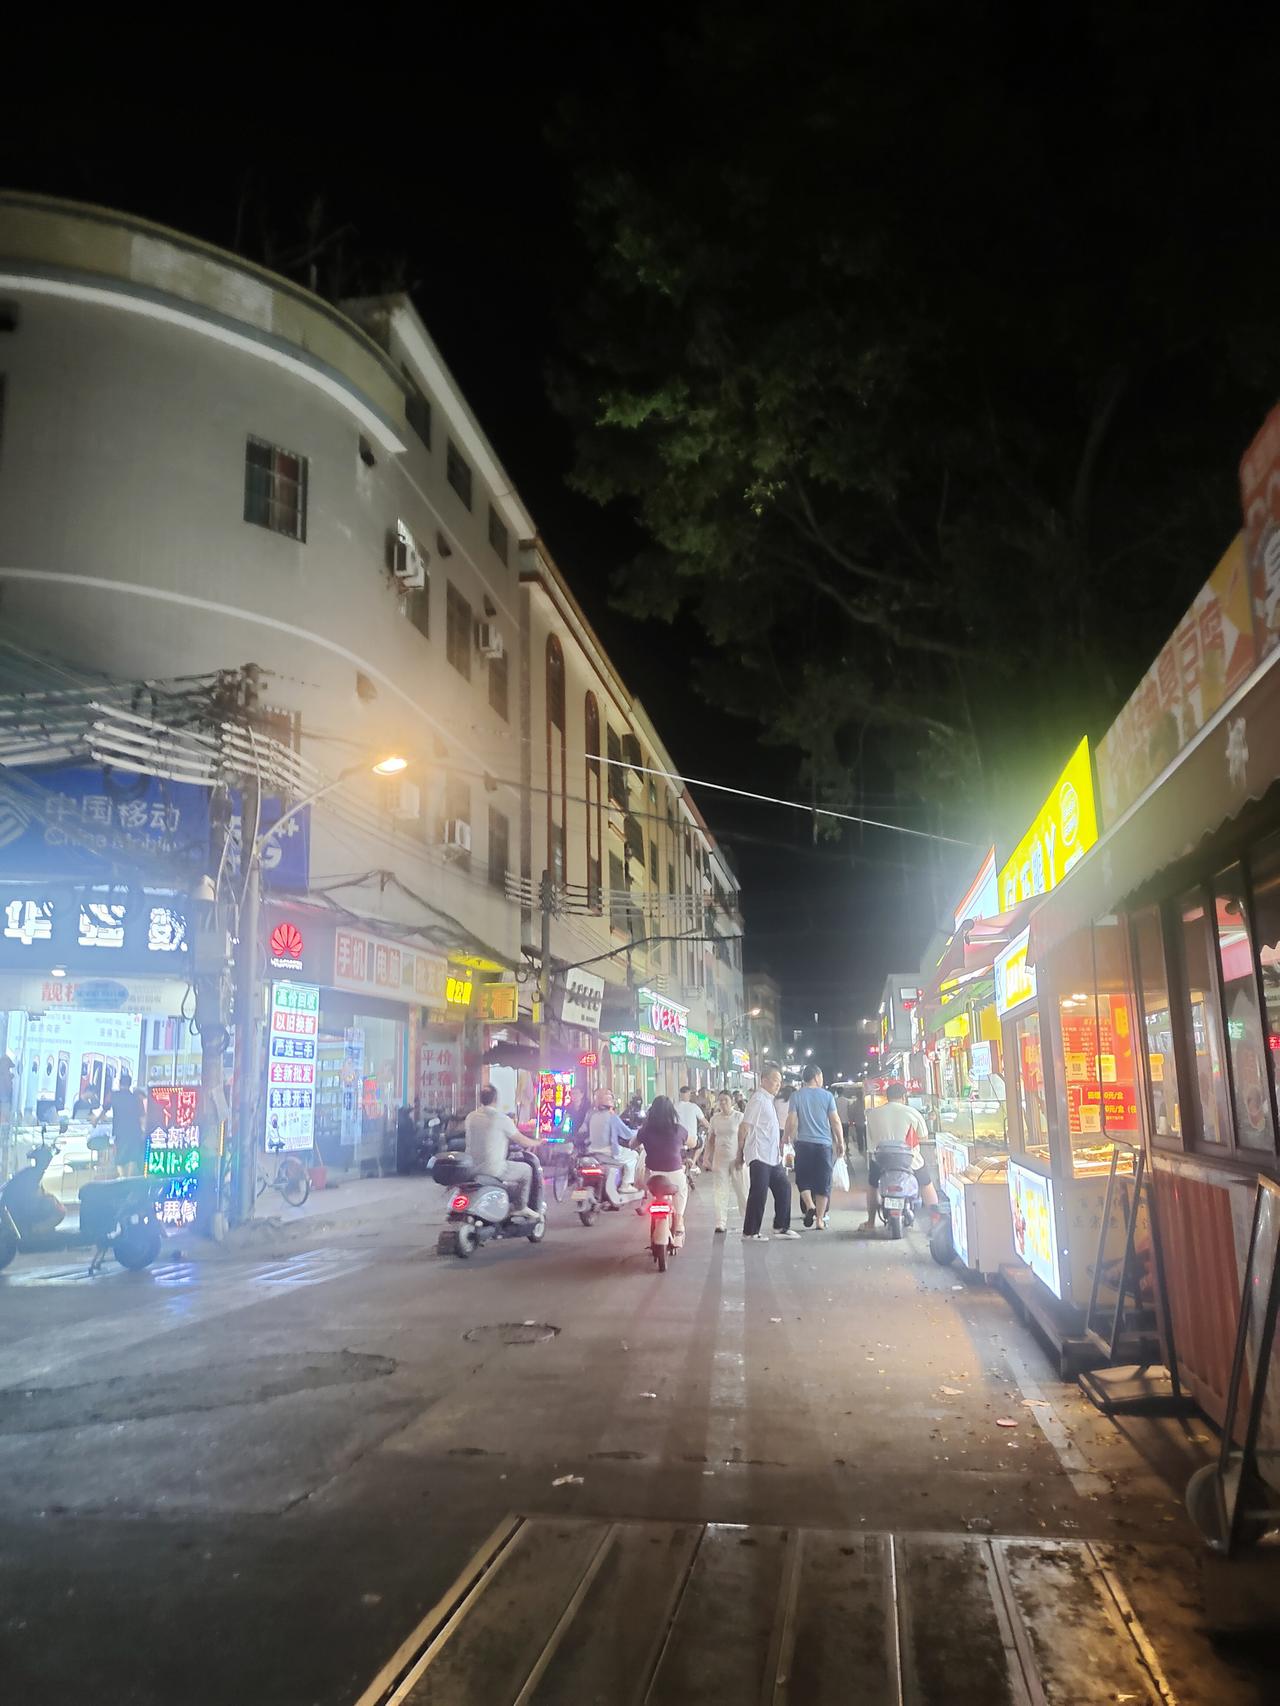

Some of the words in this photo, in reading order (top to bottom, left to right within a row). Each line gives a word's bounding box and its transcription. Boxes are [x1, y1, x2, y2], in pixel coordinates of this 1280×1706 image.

[45, 792, 181, 832] 中国移动
[337, 937, 365, 981] 手机
[275, 1012, 315, 1033] 以旧换新
[274, 1039, 313, 1057] 严选二手
[273, 1064, 312, 1082] 全新批发
